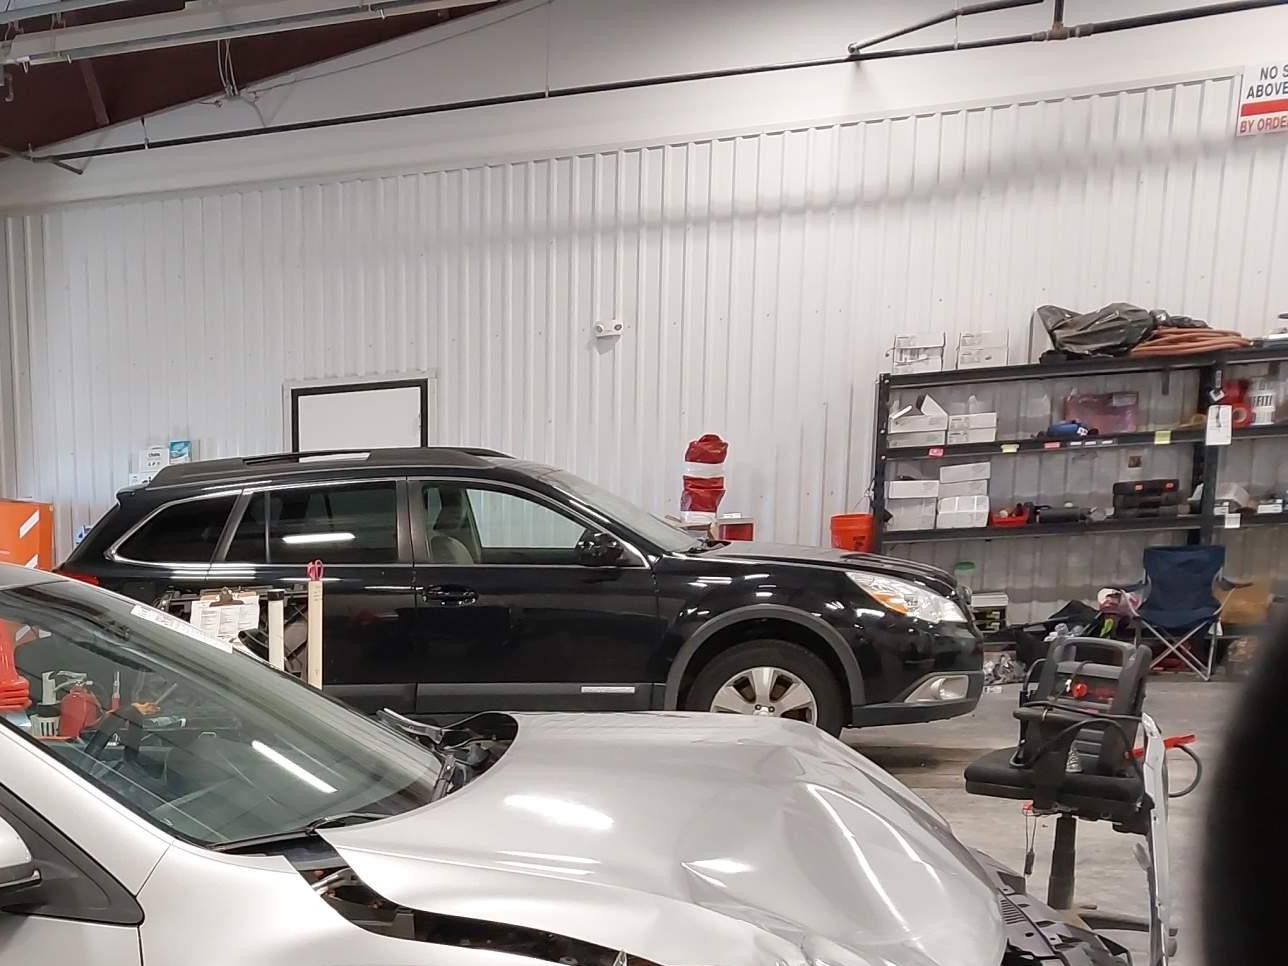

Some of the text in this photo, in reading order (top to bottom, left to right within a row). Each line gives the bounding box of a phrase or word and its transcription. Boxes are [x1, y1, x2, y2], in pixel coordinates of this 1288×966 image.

[1260, 66, 1278, 80] NO
[1247, 82, 1288, 99] ABOVE
[1240, 116, 1288, 133] BY ORDE
